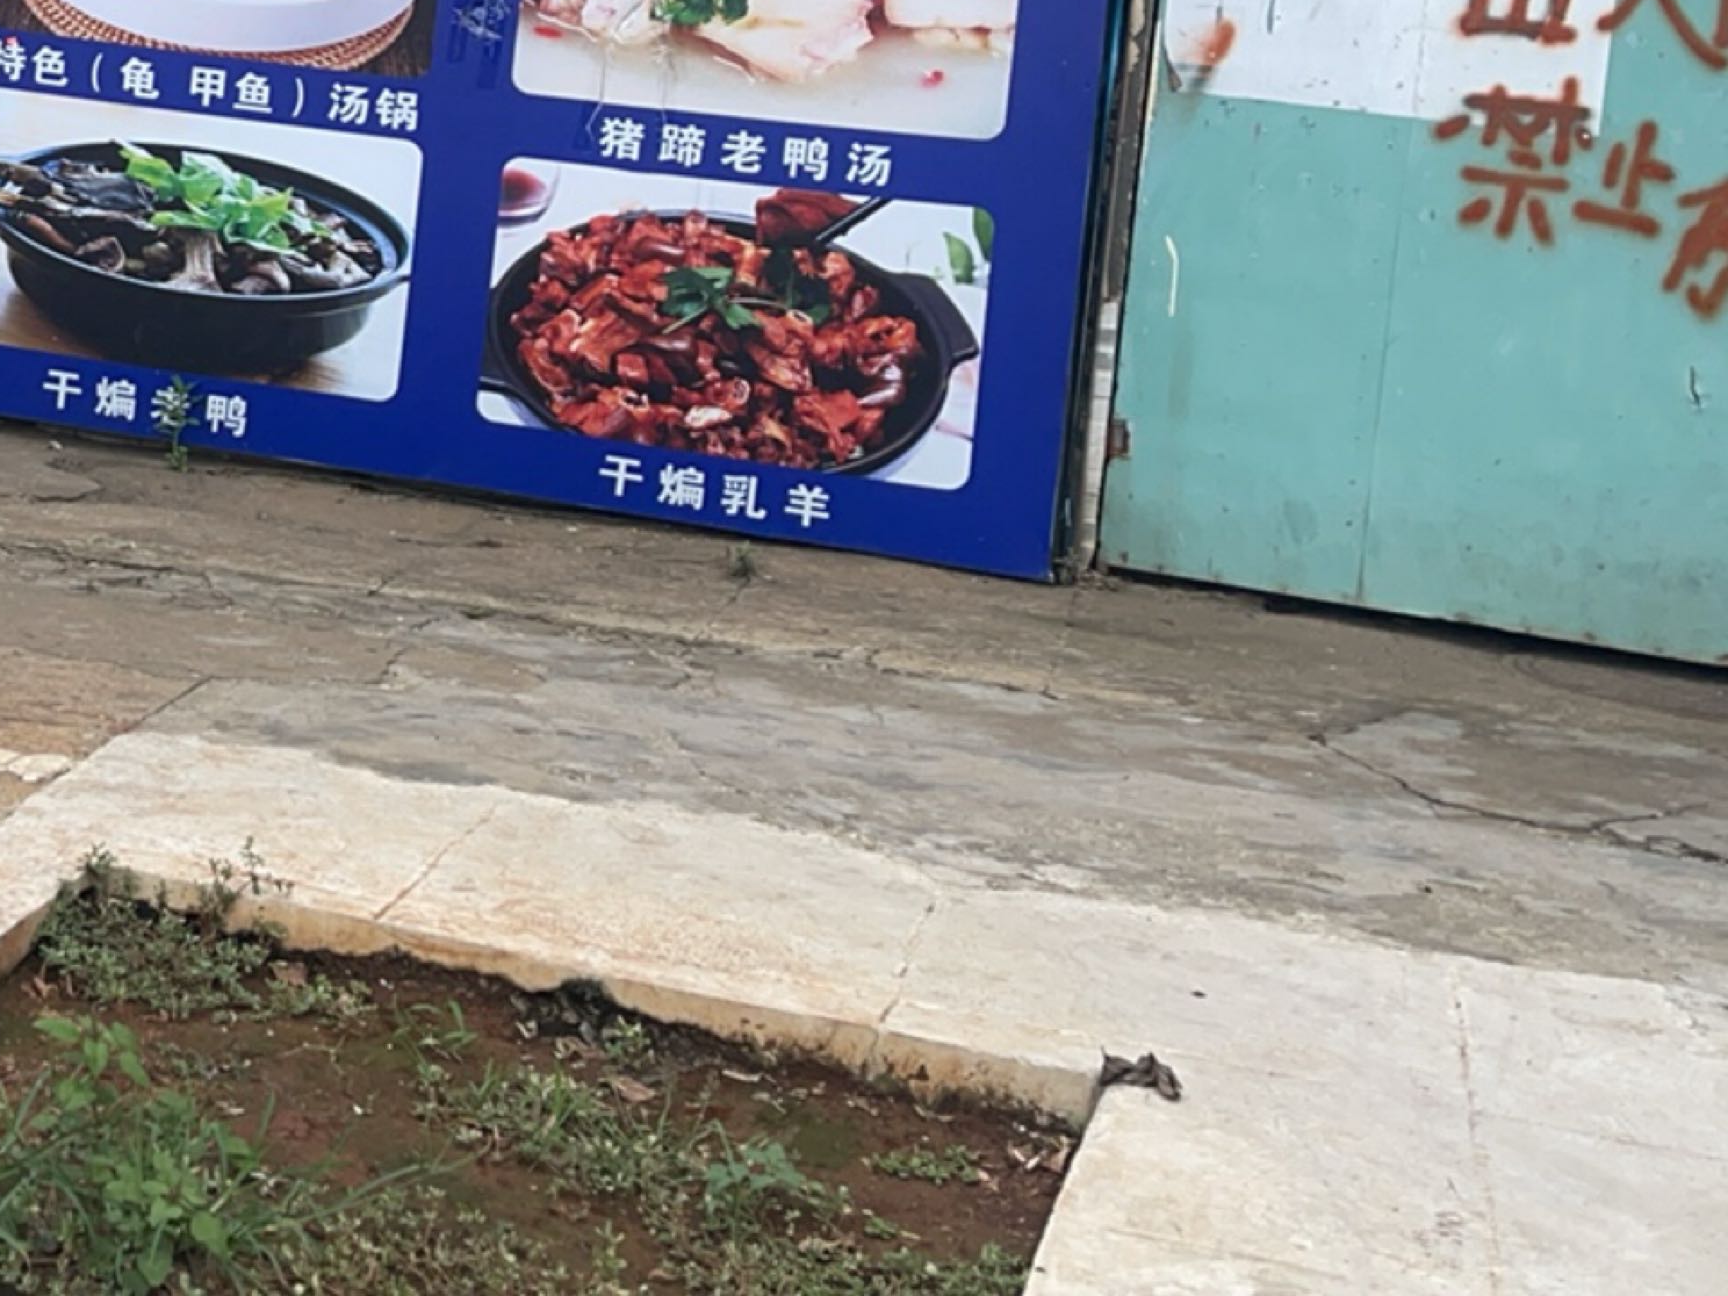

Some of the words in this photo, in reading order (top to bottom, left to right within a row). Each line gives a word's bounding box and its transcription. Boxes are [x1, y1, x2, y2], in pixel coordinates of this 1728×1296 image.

[599, 116, 892, 188] 猪蹄老鸭汤
[598, 454, 831, 528] 干煸乳羊
